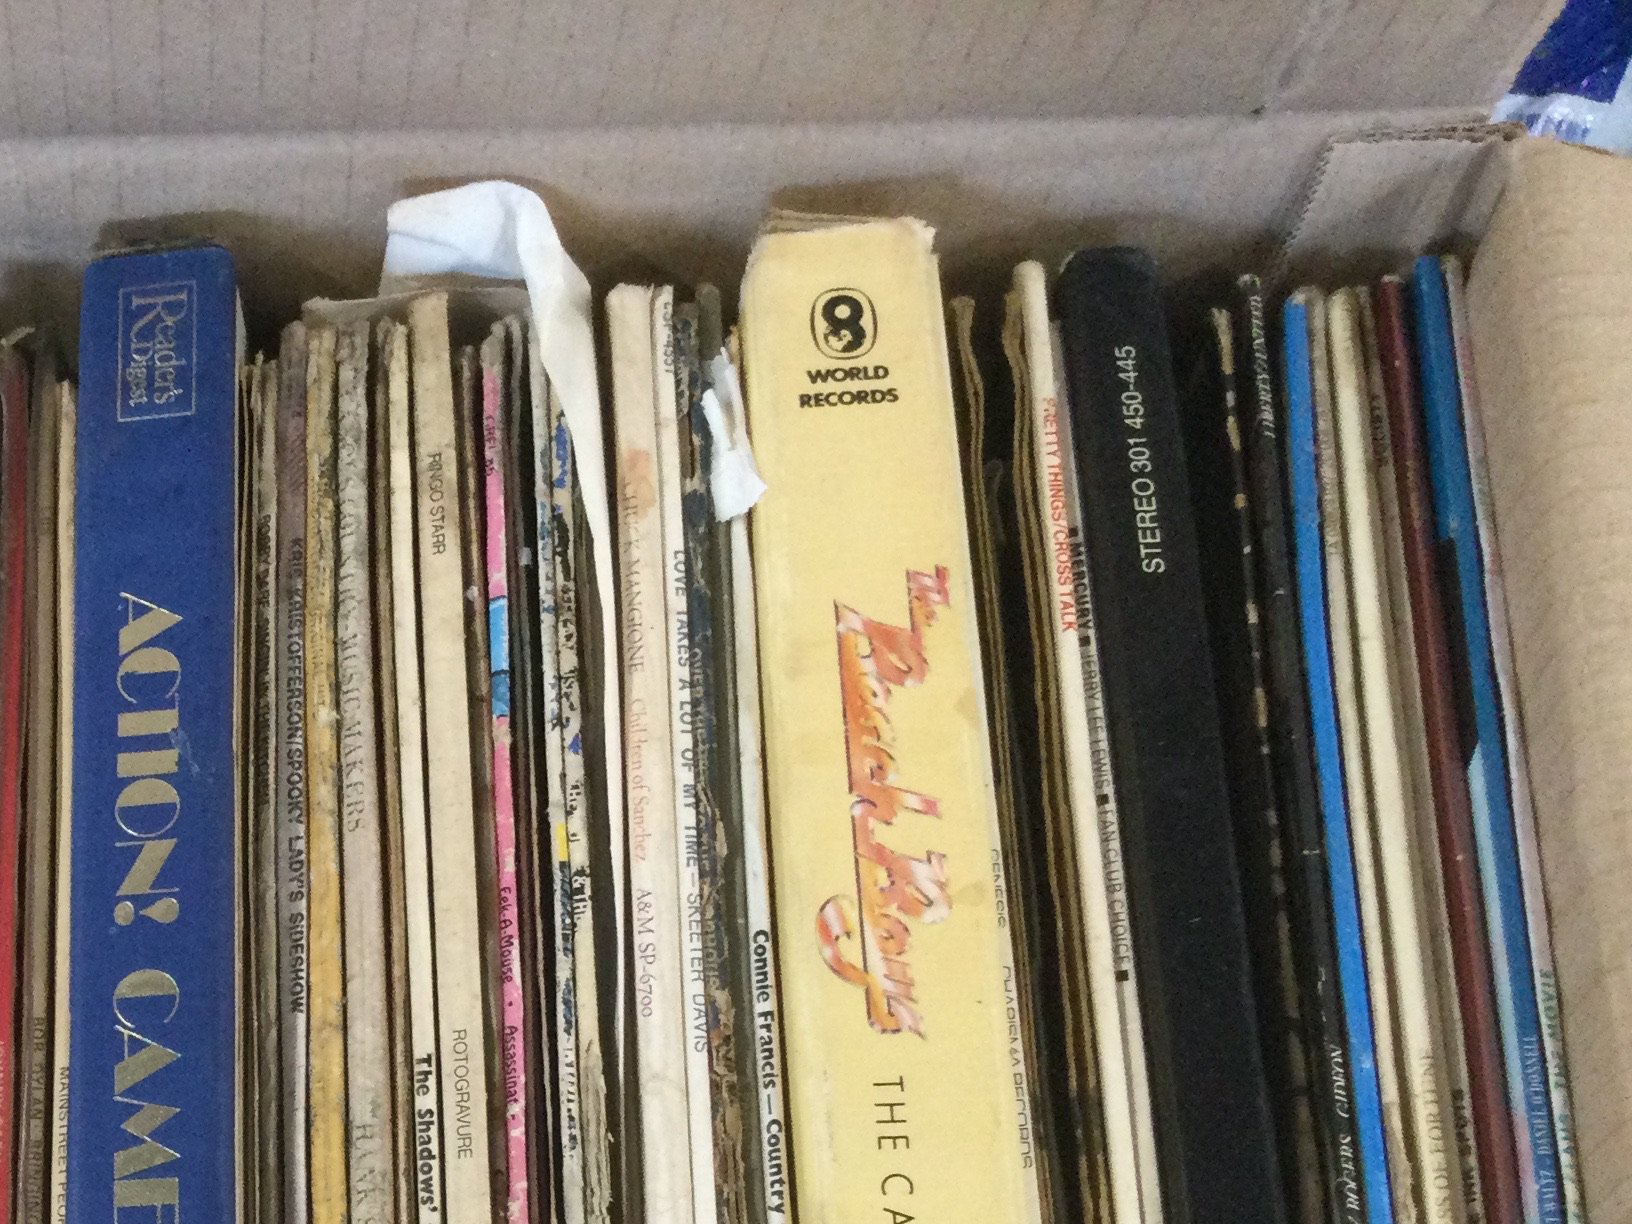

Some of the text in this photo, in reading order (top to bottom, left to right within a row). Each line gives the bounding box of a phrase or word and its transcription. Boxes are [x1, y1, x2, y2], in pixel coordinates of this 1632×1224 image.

[130, 288, 187, 405] Reader's
[806, 364, 890, 384] WORLD
[799, 388, 900, 408] RECORDS
[427, 452, 447, 556] RINGO STARR
[1114, 344, 1166, 572] STEREO 301 450-445
[114, 591, 186, 926] ACTION!
[834, 599, 940, 826] Beach
[498, 886, 516, 984] Eek-A-Mouse
[751, 928, 774, 1004] Connie
[816, 850, 950, 1040] Boys
[414, 1052, 433, 1096] The
[452, 1028, 472, 1160] ROTOGRAVURE
[757, 1010, 780, 1088] Francis
[416, 1108, 437, 1212] Shadows'
[872, 1075, 911, 1151] THE
[761, 1118, 788, 1214] Country
